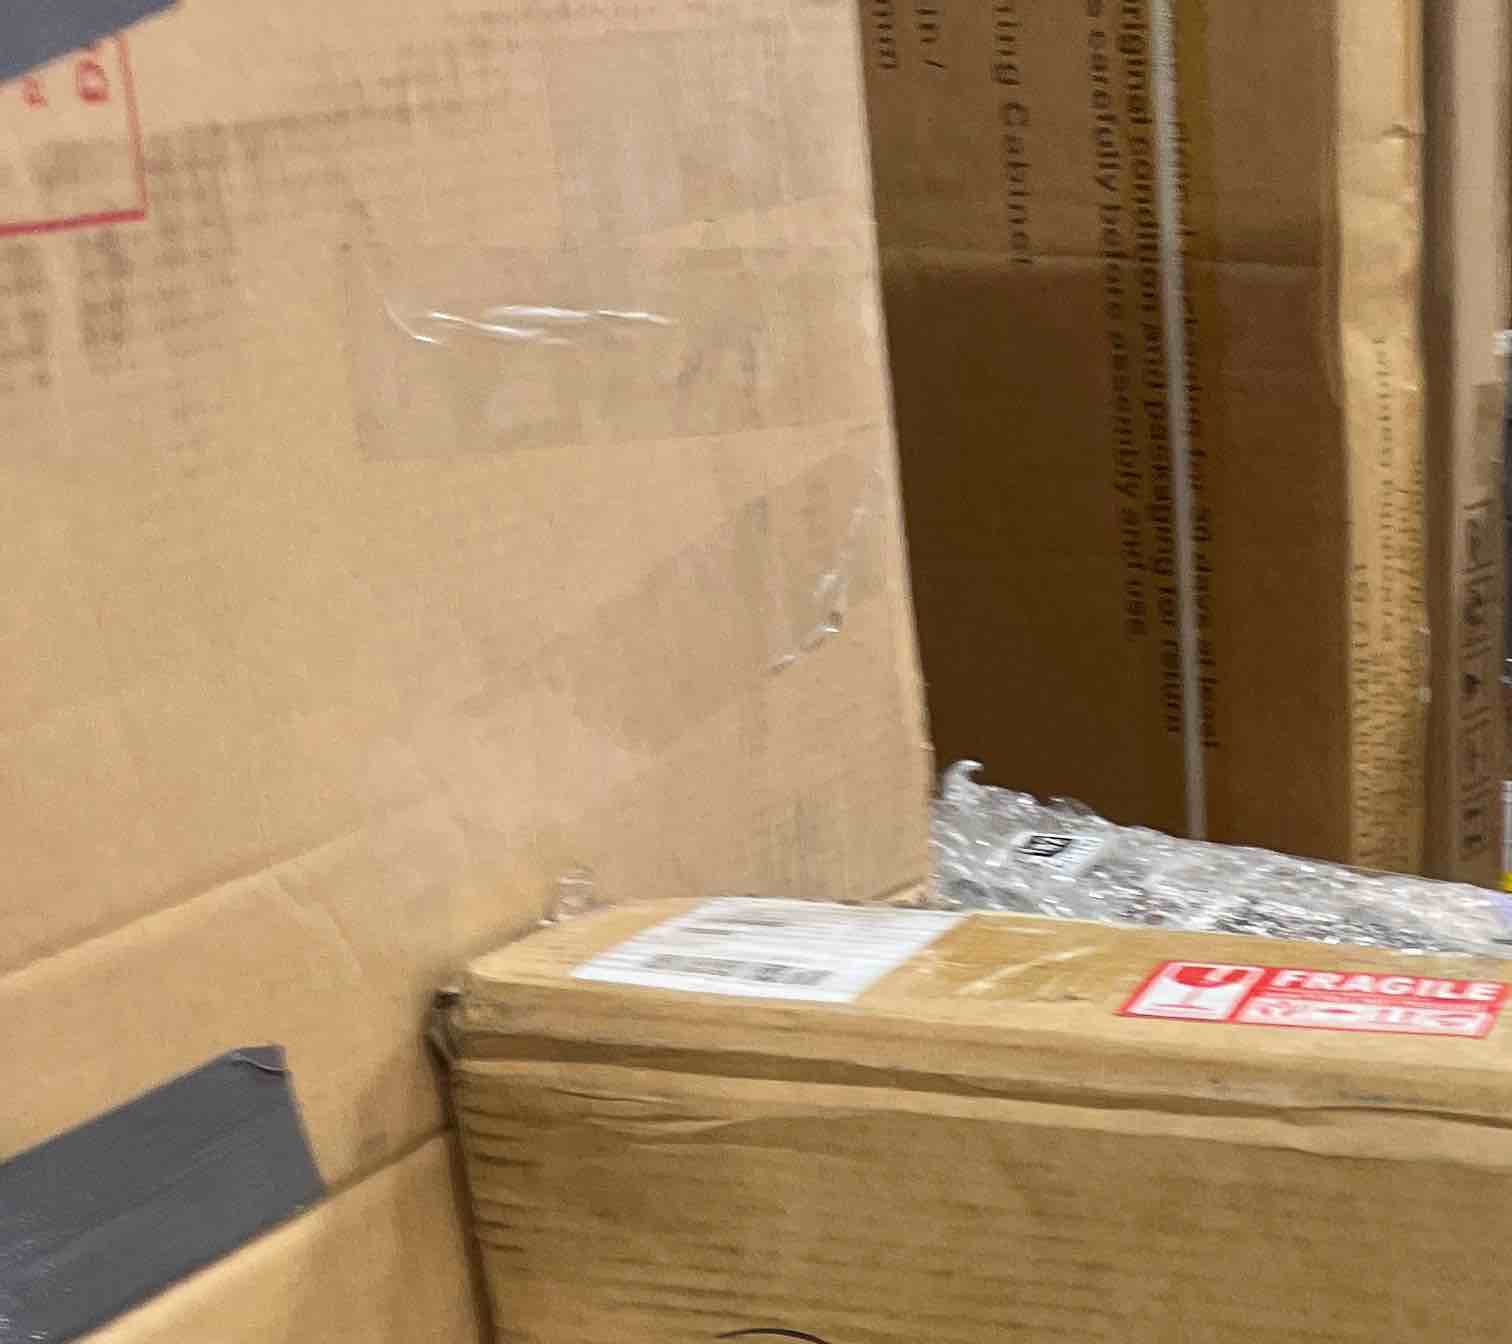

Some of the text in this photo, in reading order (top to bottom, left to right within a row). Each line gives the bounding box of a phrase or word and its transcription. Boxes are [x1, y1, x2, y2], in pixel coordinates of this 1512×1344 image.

[1087, 30, 1121, 192] carefully
[1103, 204, 1130, 320] before
[1271, 968, 1506, 1001] FRAGILE
